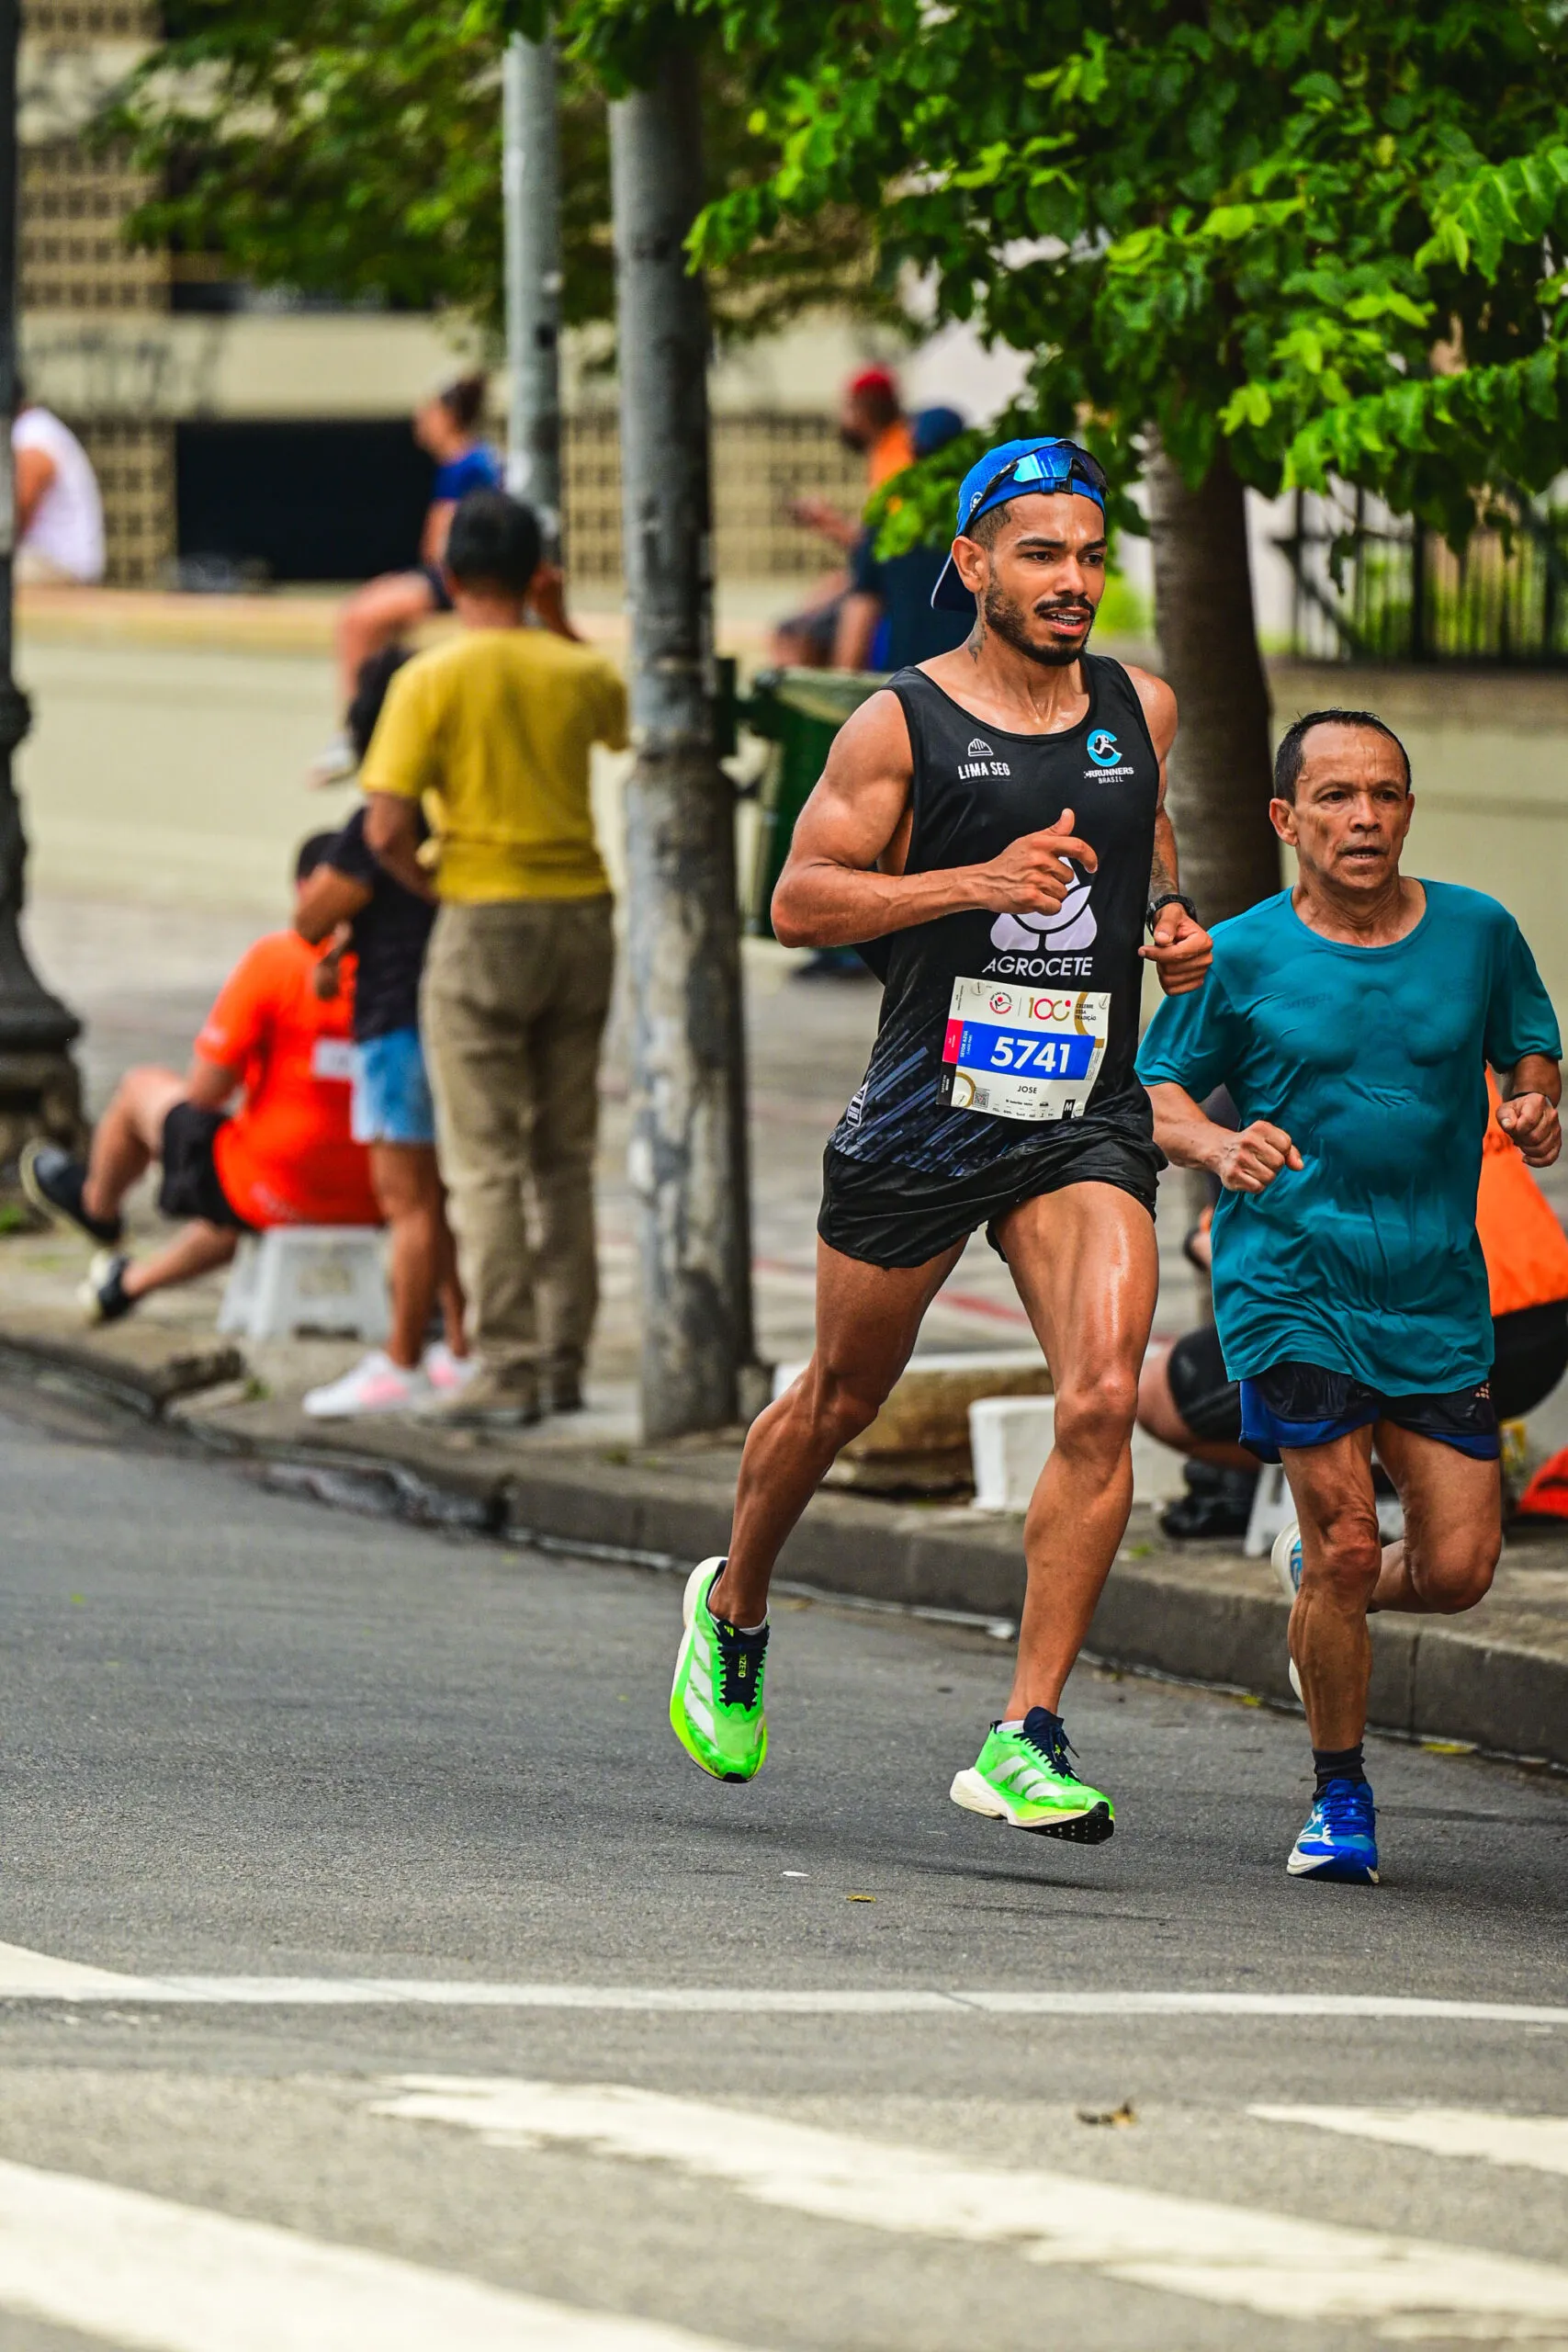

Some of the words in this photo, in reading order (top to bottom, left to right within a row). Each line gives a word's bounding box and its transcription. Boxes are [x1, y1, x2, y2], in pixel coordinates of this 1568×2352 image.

[958, 762, 989, 779] LIMA
[990, 762, 1010, 776] SEG
[1098, 776, 1124, 785] BRASIL
[982, 956, 1093, 977] AGROCETE
[990, 1036, 1071, 1073] 5741
[1017, 1085, 1038, 1094] JOSE
[1064, 1103, 1072, 1112] M
